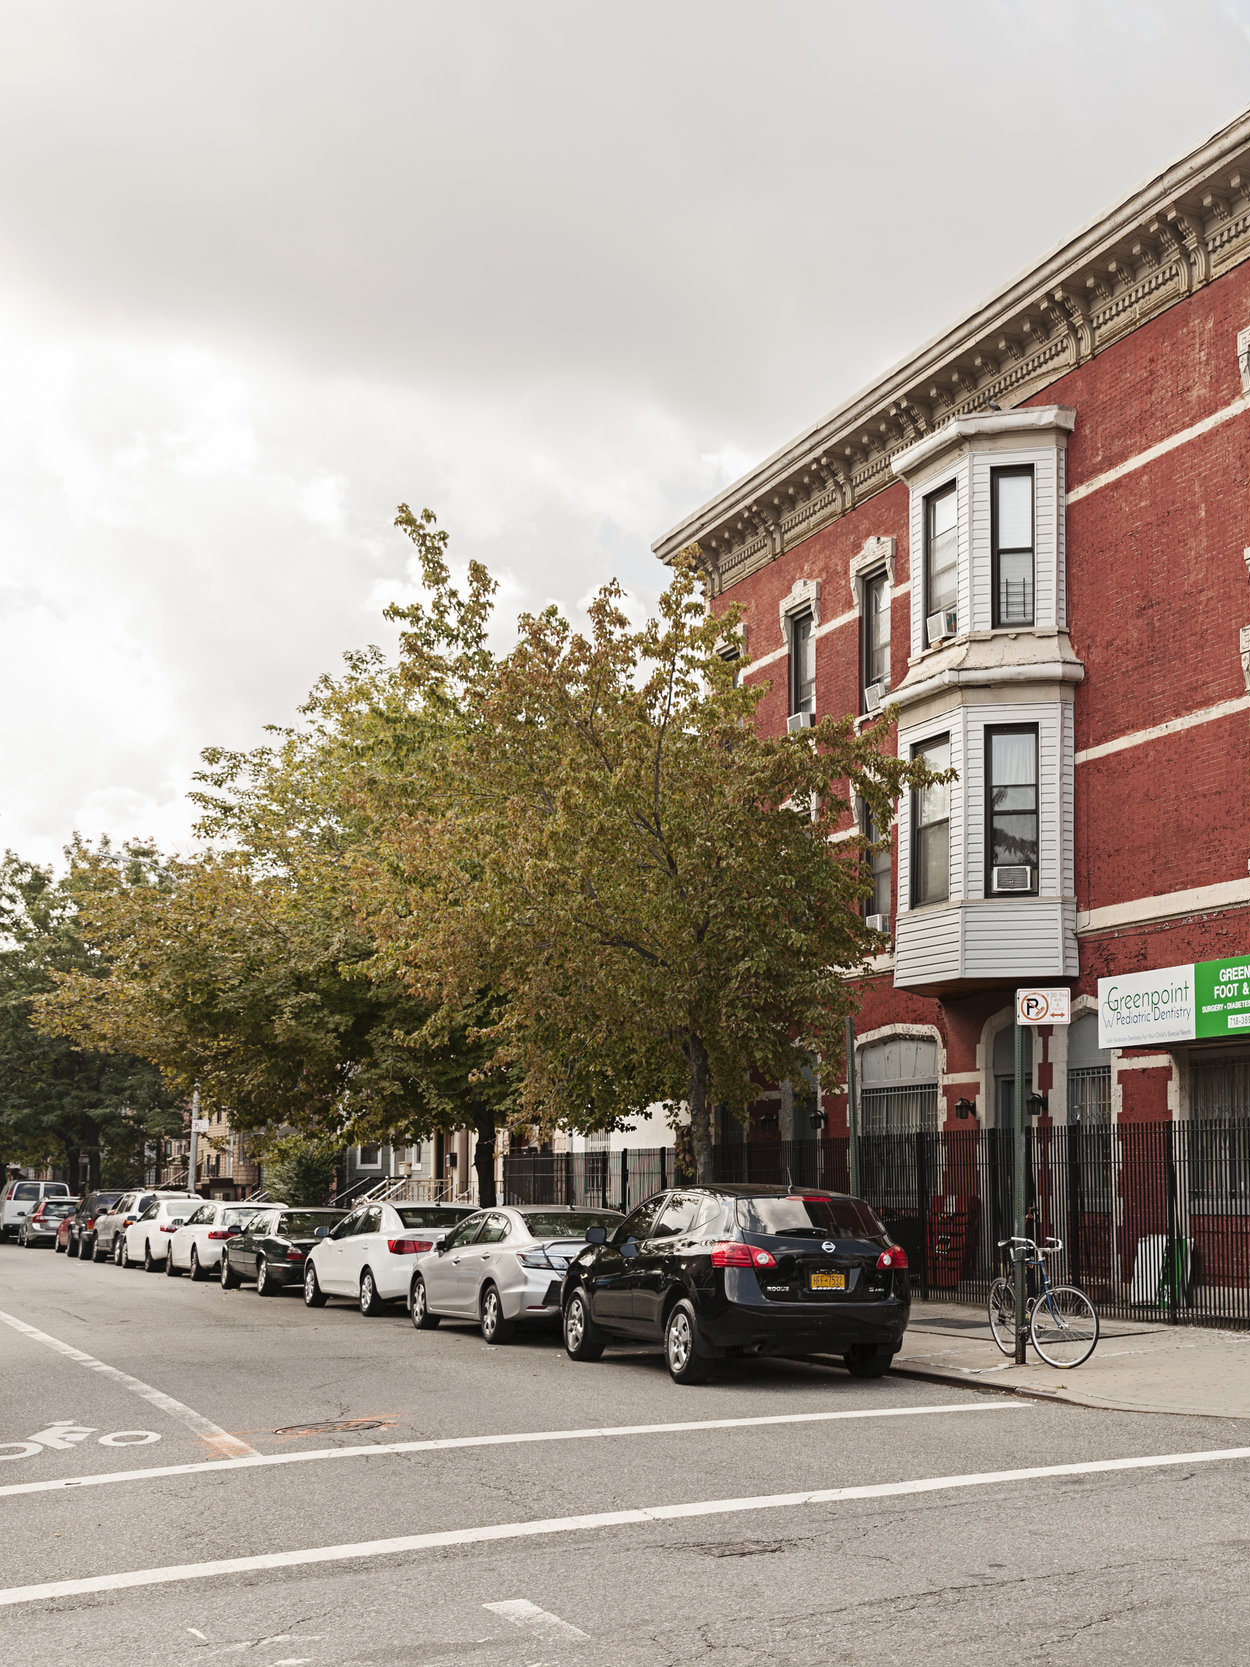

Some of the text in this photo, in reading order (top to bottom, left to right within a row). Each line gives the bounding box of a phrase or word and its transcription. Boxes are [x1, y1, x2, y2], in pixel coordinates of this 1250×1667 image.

[1107, 980, 1189, 1012] Greenpoint
[1214, 983, 1239, 999] FOOT
[1242, 982, 1250, 995] &
[1116, 1006, 1191, 1026] Pediatric Dentistry
[1202, 1003, 1224, 1013] SURGERY
